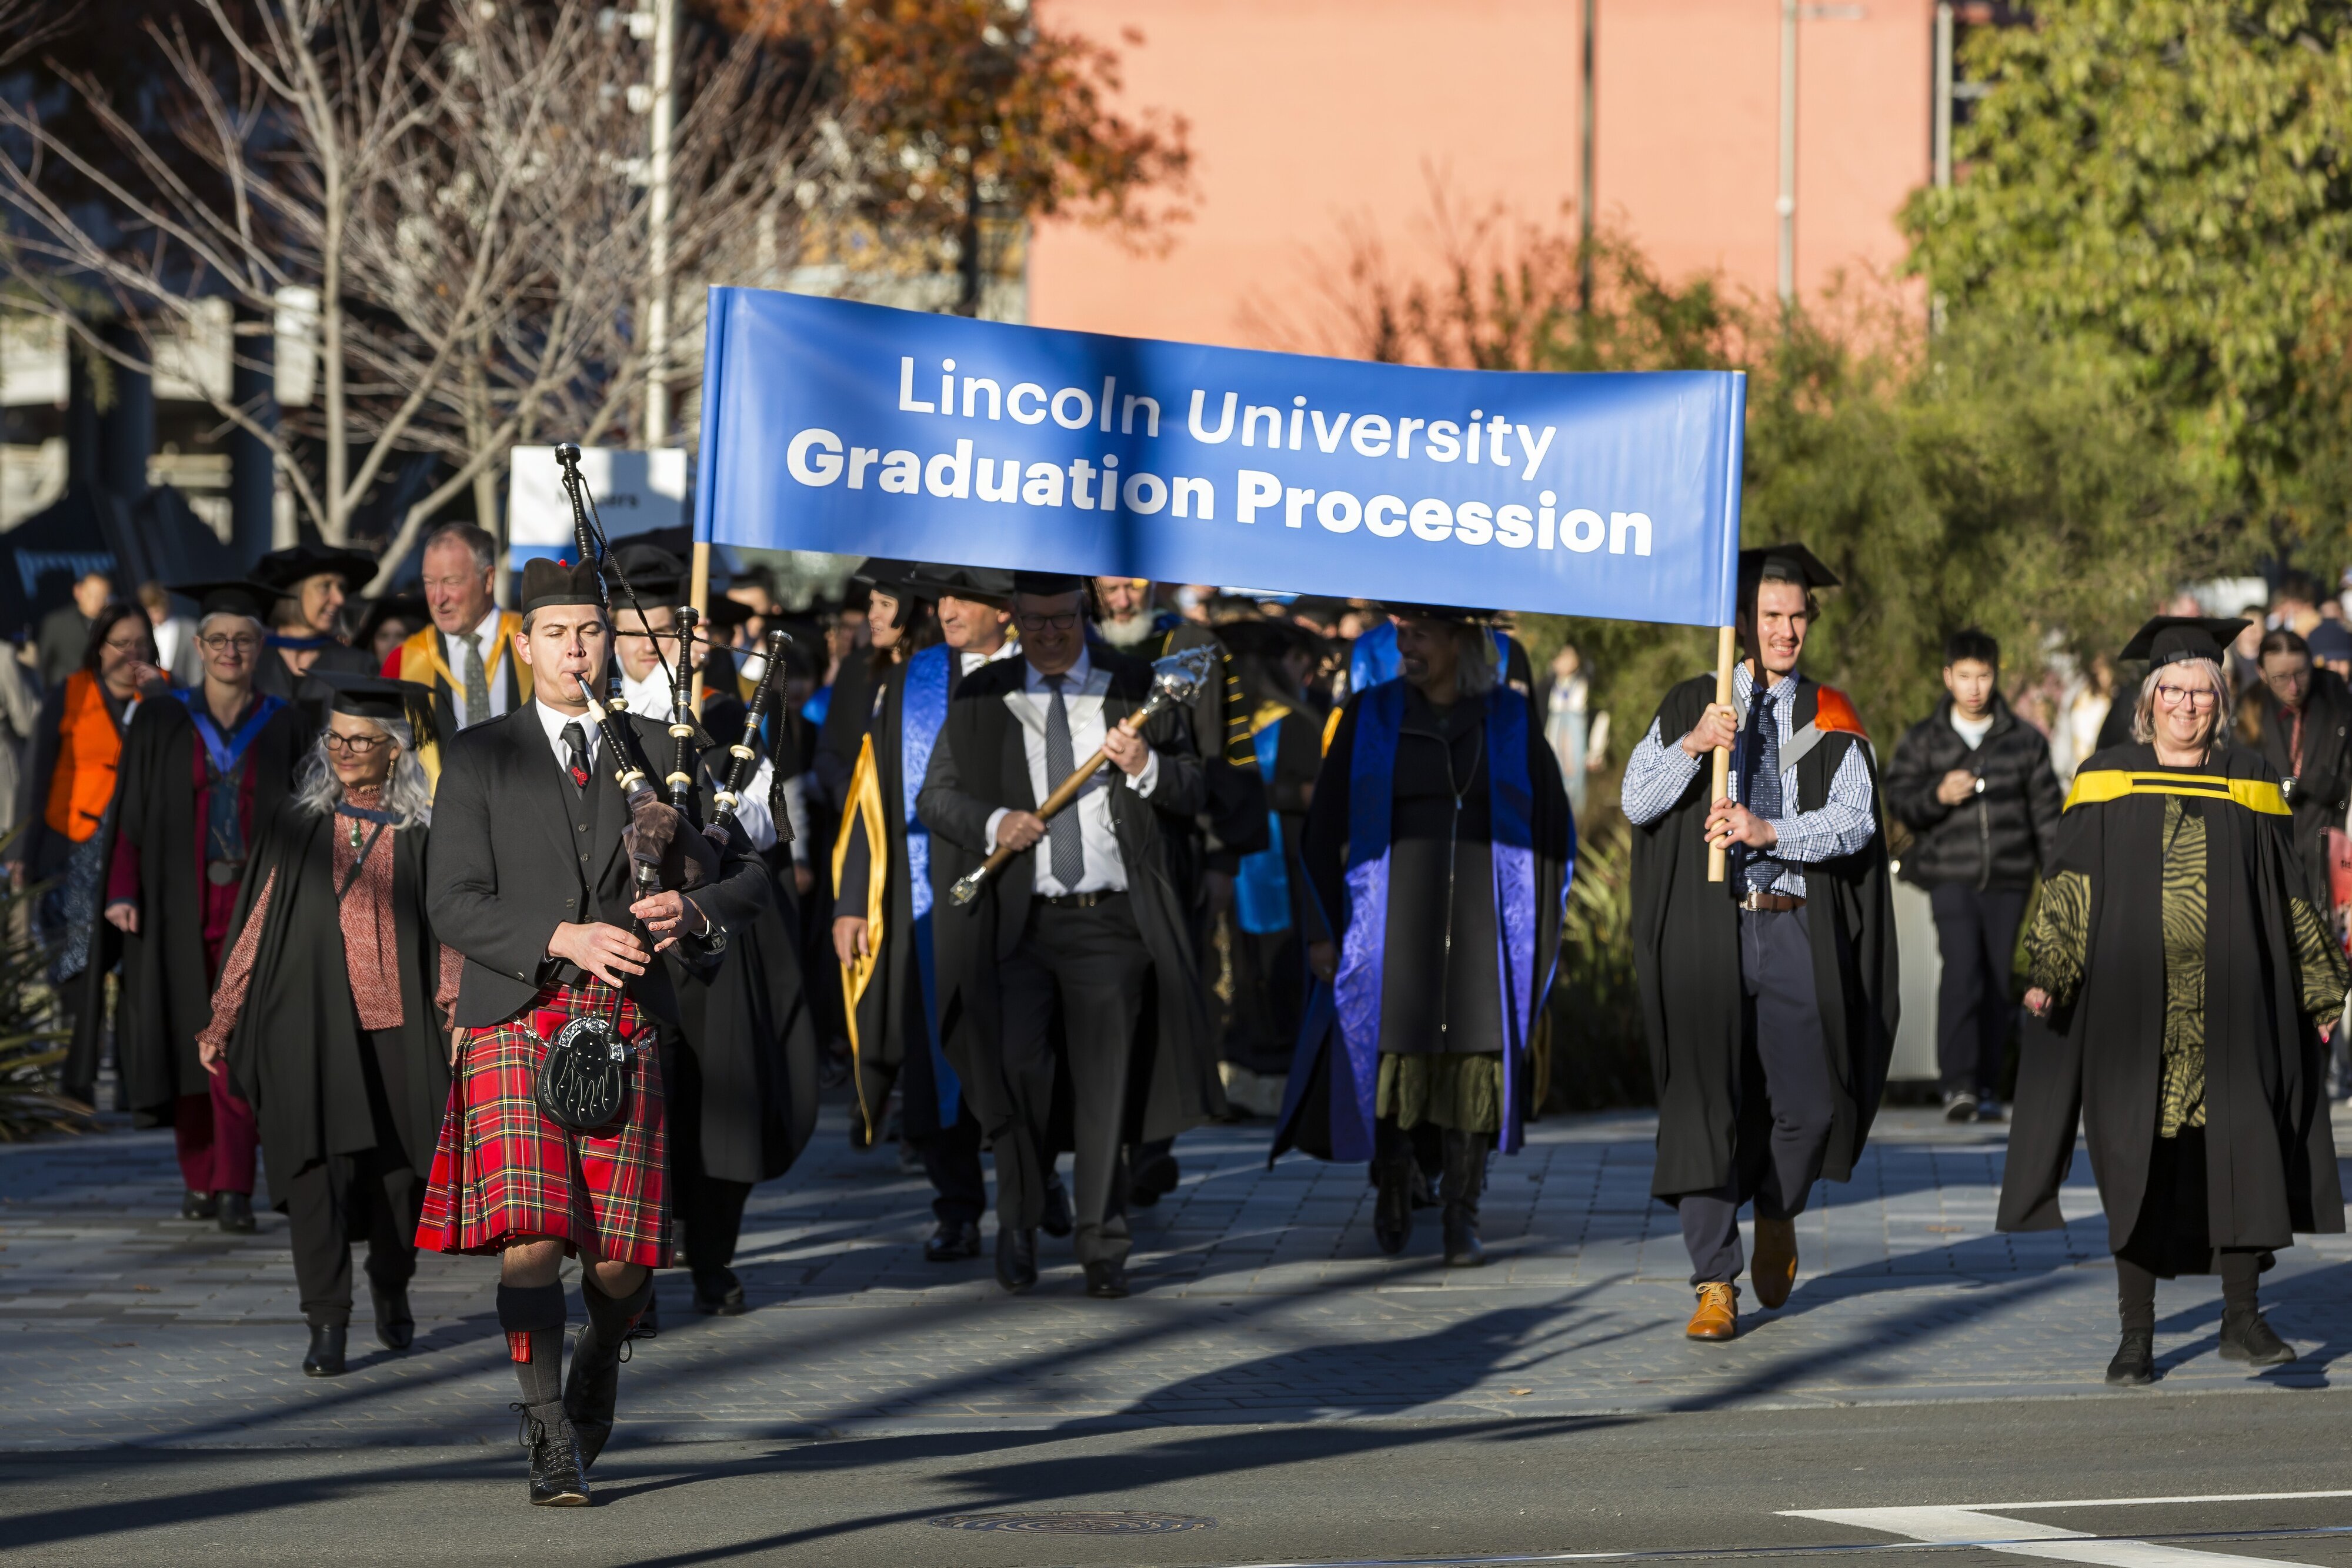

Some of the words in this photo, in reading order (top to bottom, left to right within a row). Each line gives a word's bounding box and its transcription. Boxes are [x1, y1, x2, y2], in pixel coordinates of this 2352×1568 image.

[899, 356, 1160, 438] Lincoln
[1187, 389, 1557, 481] University
[786, 428, 1215, 521] Graduation
[1236, 469, 1653, 556] Procession
